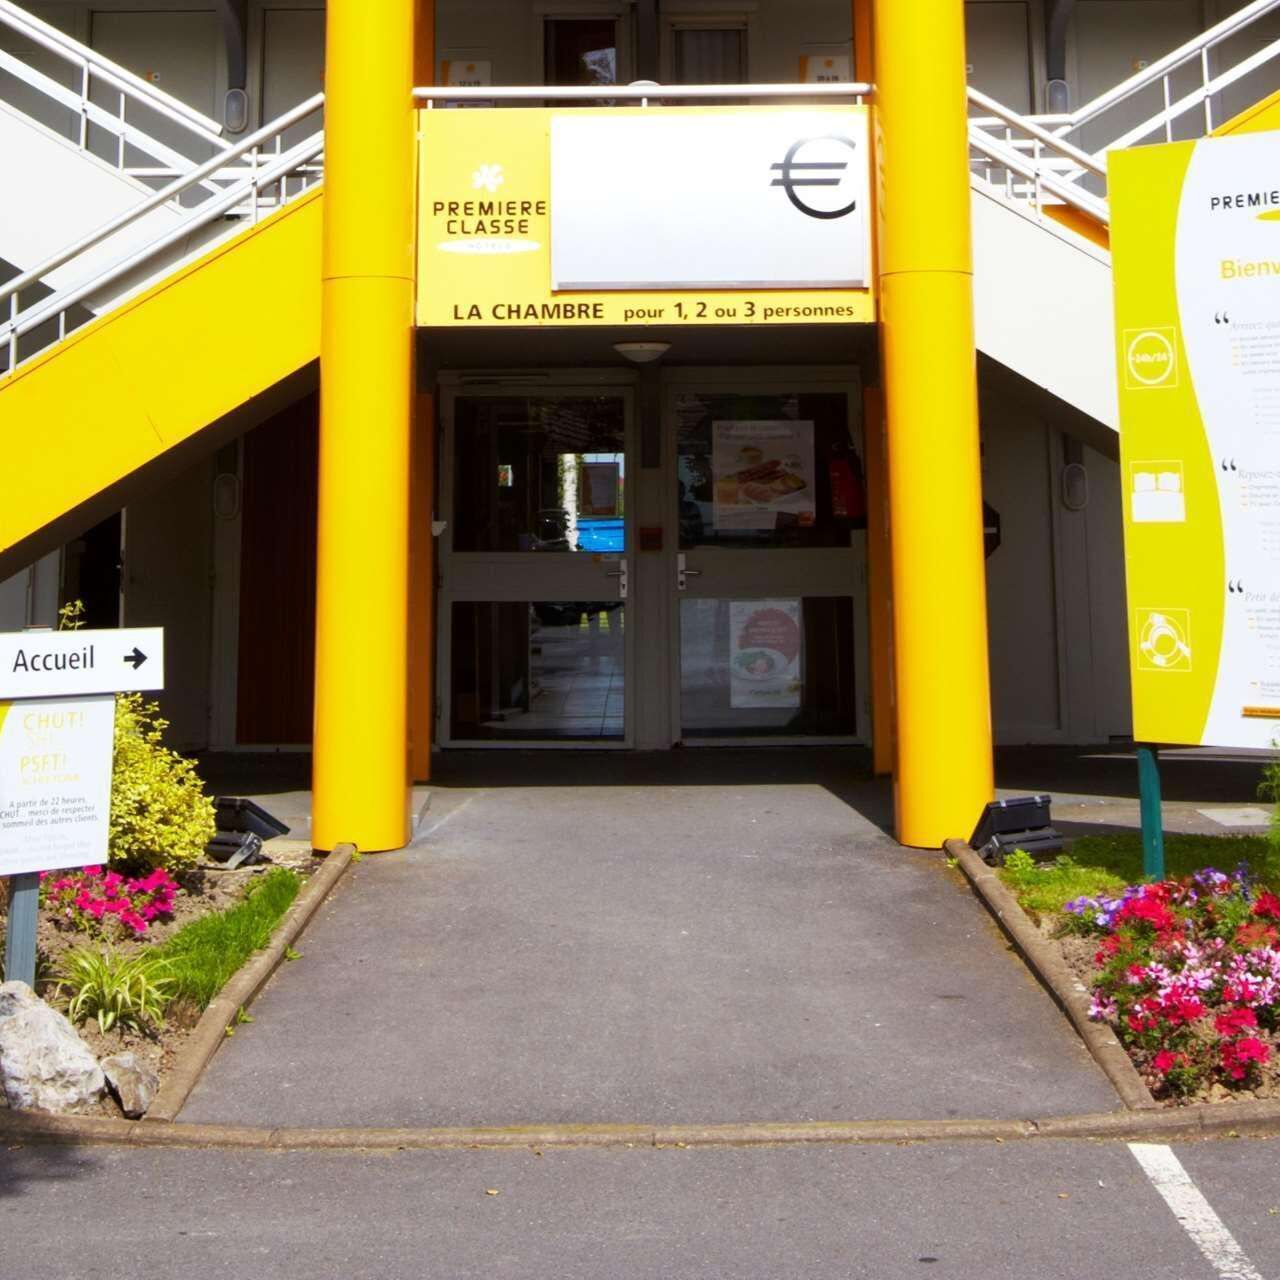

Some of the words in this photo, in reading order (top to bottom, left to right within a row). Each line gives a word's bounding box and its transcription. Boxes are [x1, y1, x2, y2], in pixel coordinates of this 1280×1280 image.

[433, 200, 547, 216] PREMIERE
[446, 218, 529, 235] CLASSE
[453, 305, 483, 320] LA
[491, 302, 604, 319] CHAMBRE
[623, 305, 664, 322] pour
[674, 302, 689, 320] 1,
[695, 301, 708, 318] 2
[714, 305, 737, 318] ou
[743, 301, 756, 318] 3
[763, 304, 854, 321] personnes
[12, 645, 95, 672] Accueil
[39, 798, 48, 807] de
[50, 797, 60, 806] 22
[50, 807, 59, 815] de
[35, 817, 48, 826] des
[50, 816, 73, 825] autres
